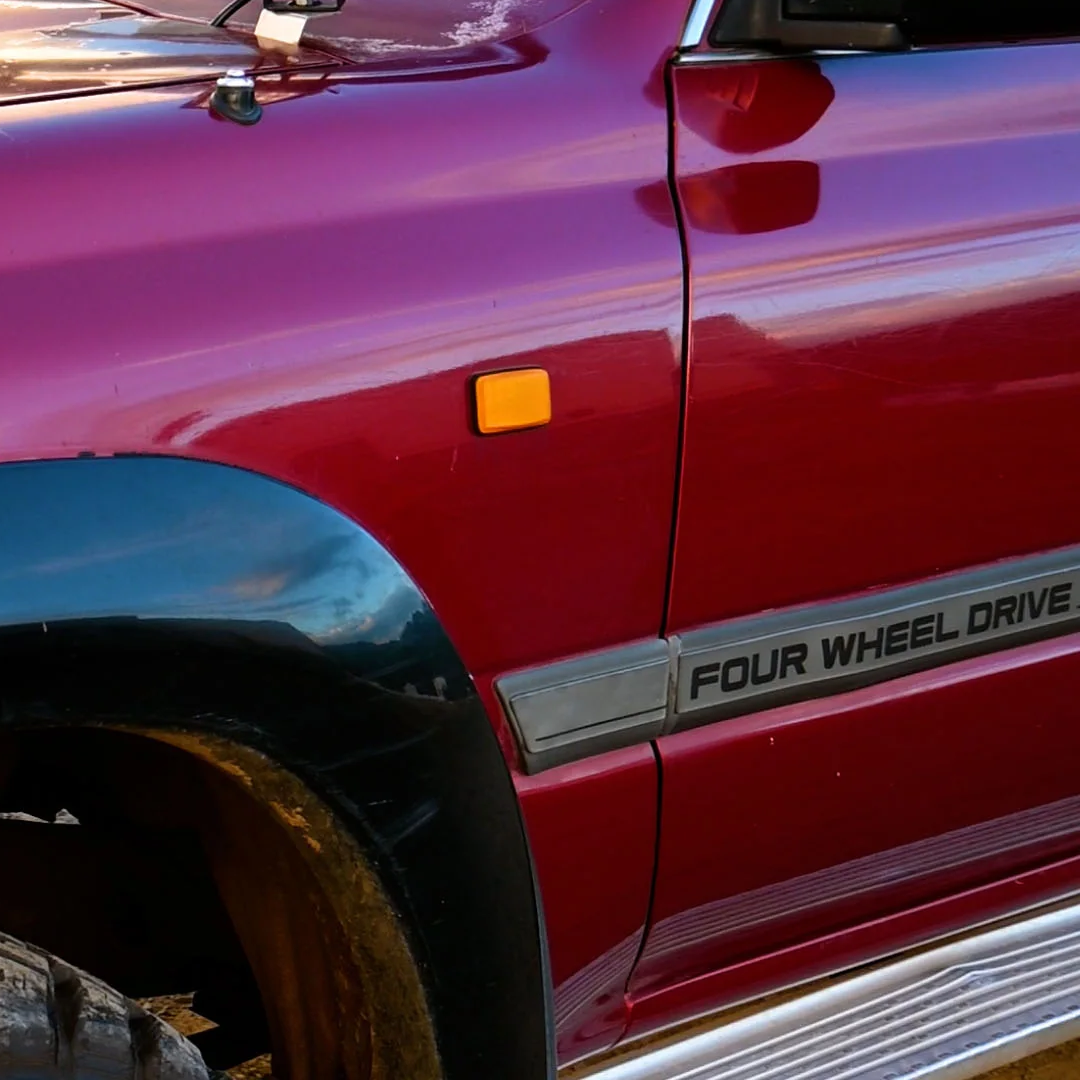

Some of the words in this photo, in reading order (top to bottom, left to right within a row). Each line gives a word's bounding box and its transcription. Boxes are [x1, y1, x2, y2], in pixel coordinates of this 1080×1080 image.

[689, 643, 809, 701] FOUR
[821, 612, 959, 670] WHEEL
[966, 581, 1073, 636] DRIVE
